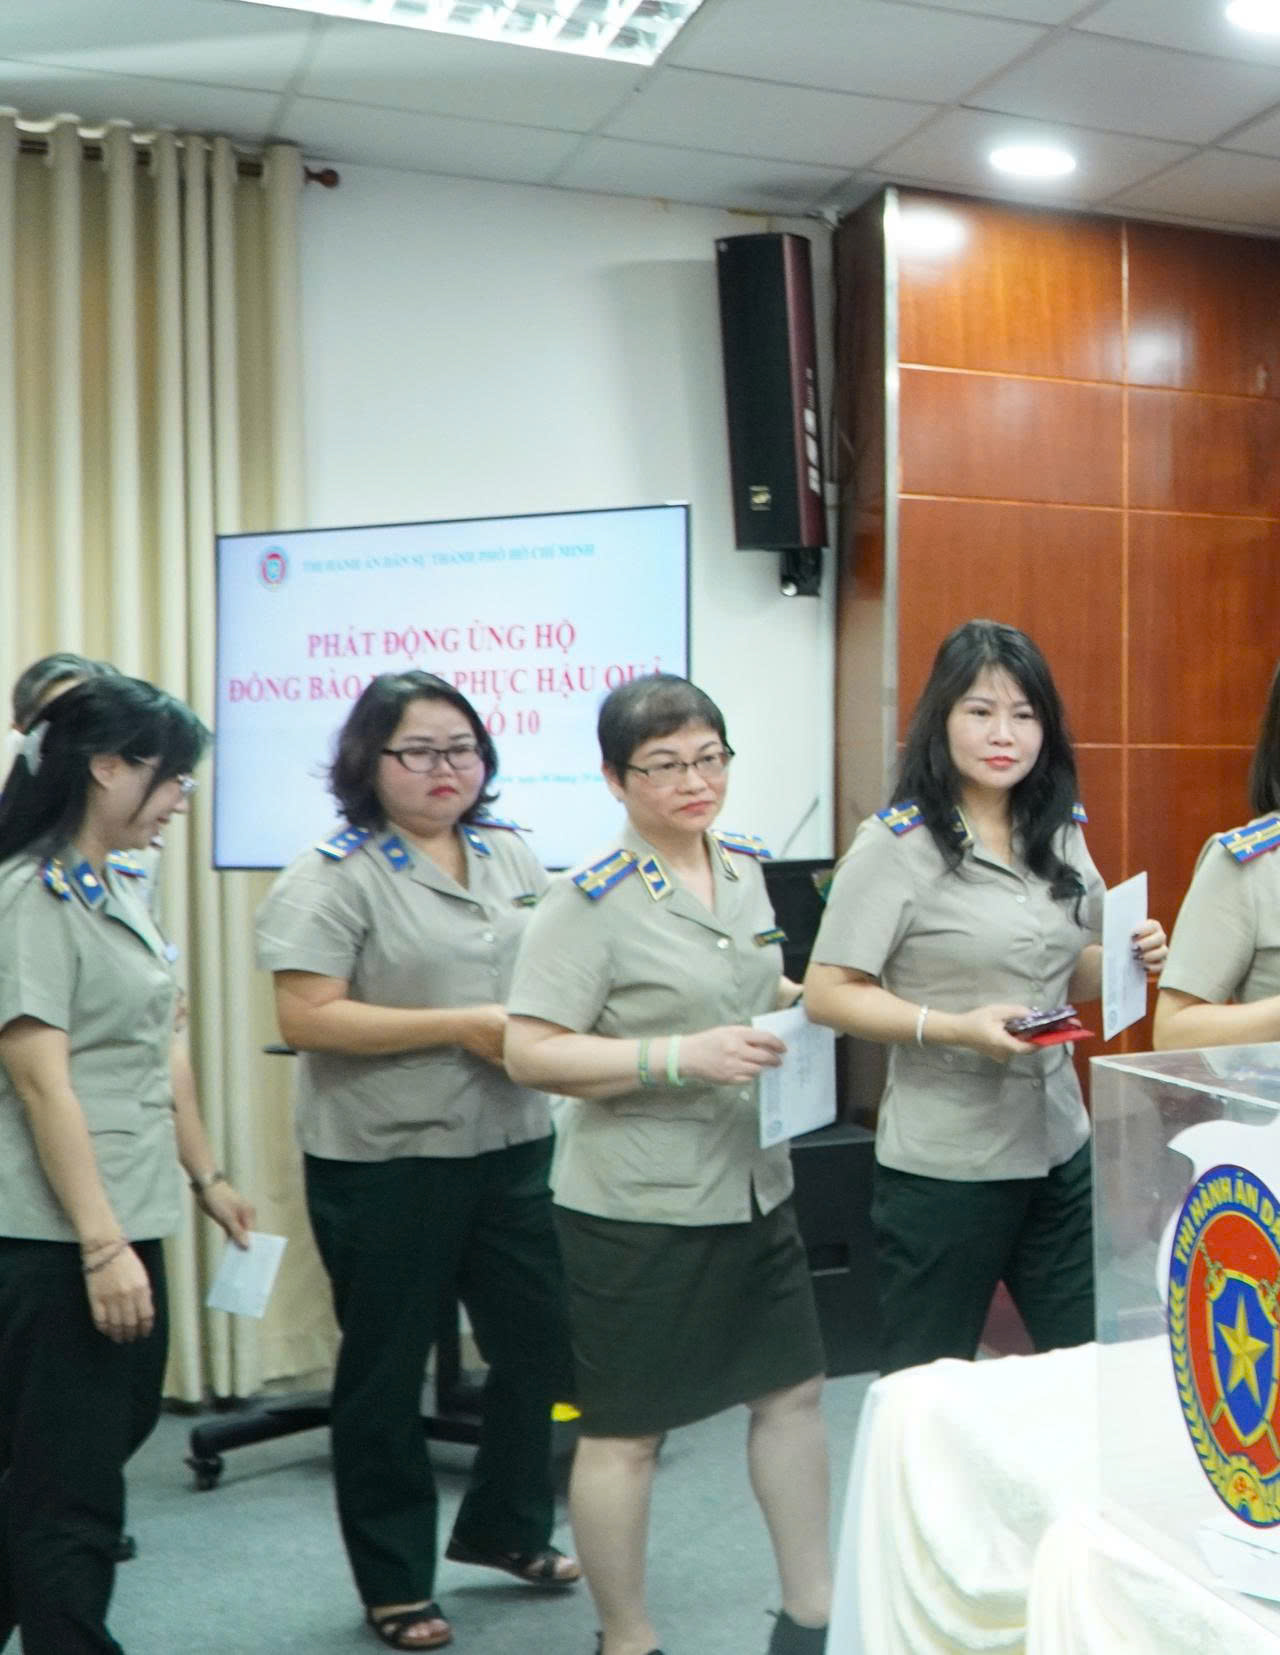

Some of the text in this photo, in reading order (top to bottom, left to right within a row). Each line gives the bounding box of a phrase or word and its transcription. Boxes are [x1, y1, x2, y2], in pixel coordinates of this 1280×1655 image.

[307, 626, 376, 658] PHÁT
[384, 624, 459, 660] ĐỘNG
[535, 619, 576, 654] HỘ
[228, 671, 301, 701] ĐỒNG
[309, 666, 362, 700] BÀO
[536, 662, 595, 699] HẬU
[479, 704, 541, 737] Ố 10
[1174, 1216, 1197, 1265] THI
[1188, 1177, 1234, 1227] HÀNH
[1234, 1171, 1259, 1213] ÁN
